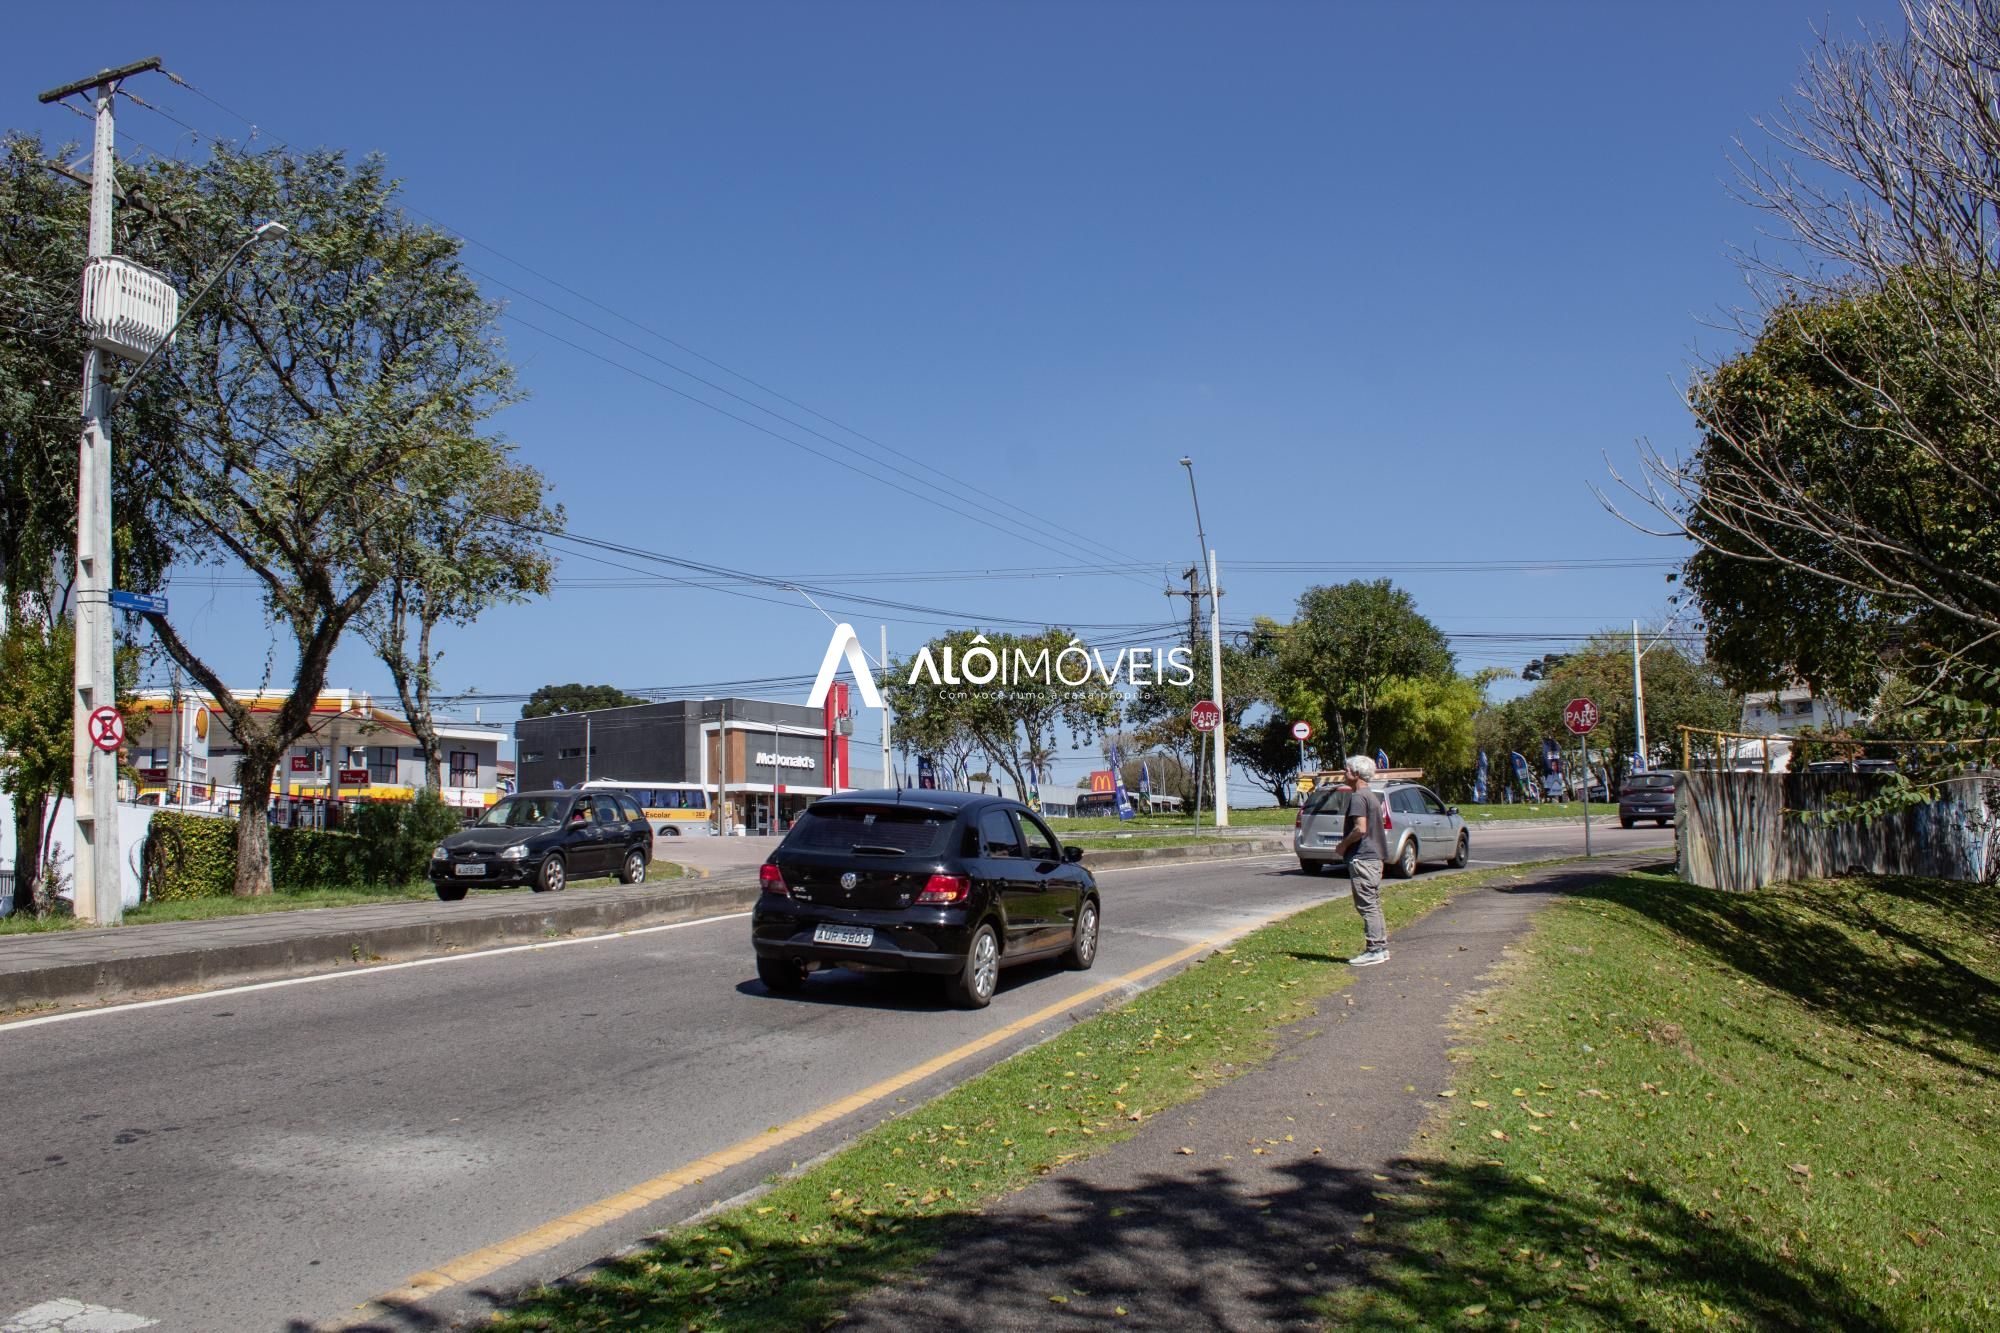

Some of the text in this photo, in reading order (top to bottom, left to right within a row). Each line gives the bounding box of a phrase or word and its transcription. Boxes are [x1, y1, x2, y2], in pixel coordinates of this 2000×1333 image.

[1193, 711, 1220, 721] PARE
[1566, 709, 1596, 722] PARE
[755, 752, 816, 769] McDonald's
